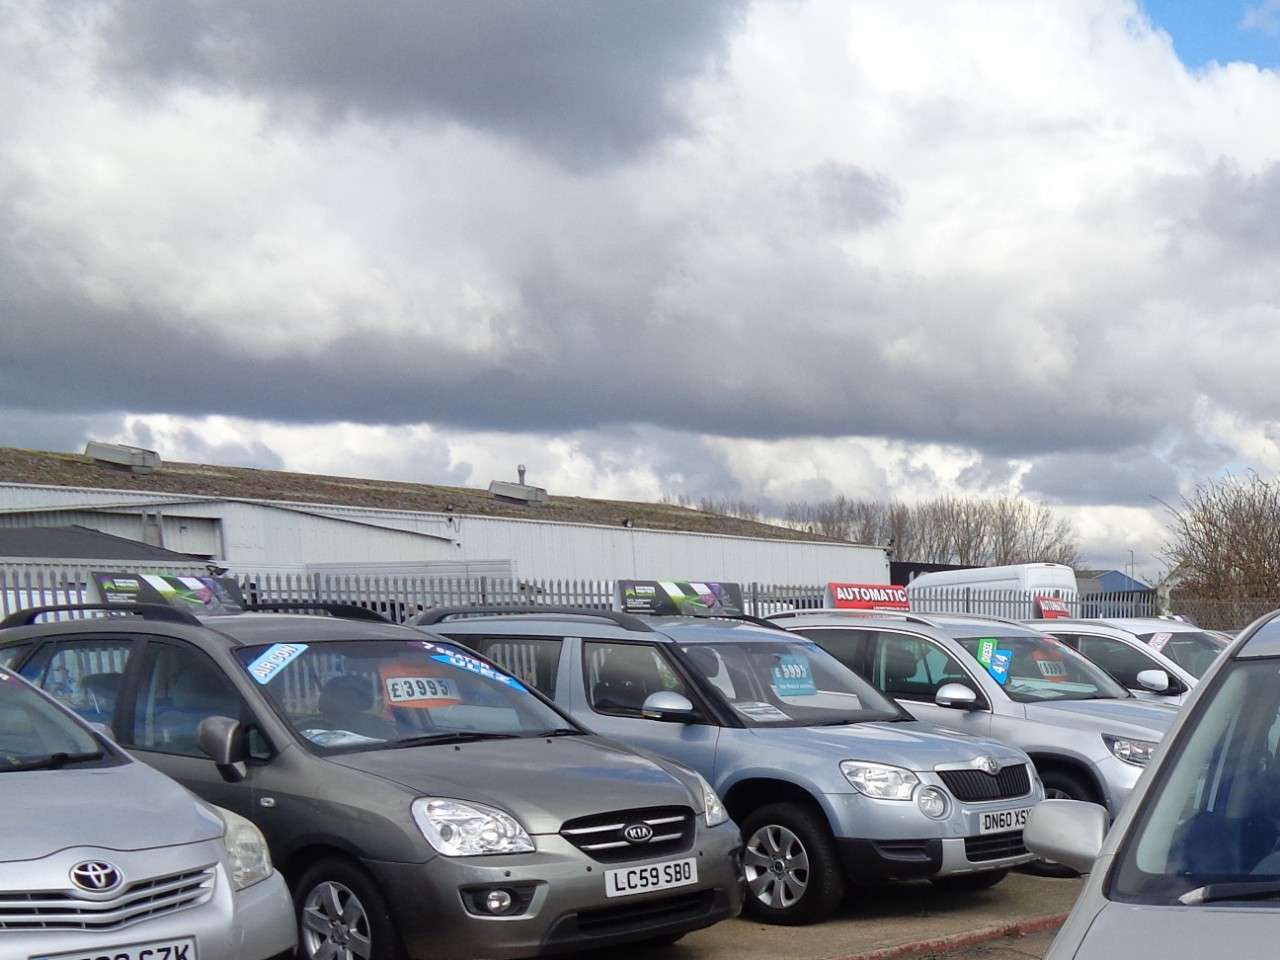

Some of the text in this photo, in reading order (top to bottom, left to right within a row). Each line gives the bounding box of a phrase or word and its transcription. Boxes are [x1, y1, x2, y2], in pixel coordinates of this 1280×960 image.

[837, 587, 907, 602] AUTOMATIC
[391, 679, 449, 699] £3995
[984, 812, 1012, 830] DN60
[629, 828, 650, 839] KIA
[613, 862, 691, 892] LC59 SBO
